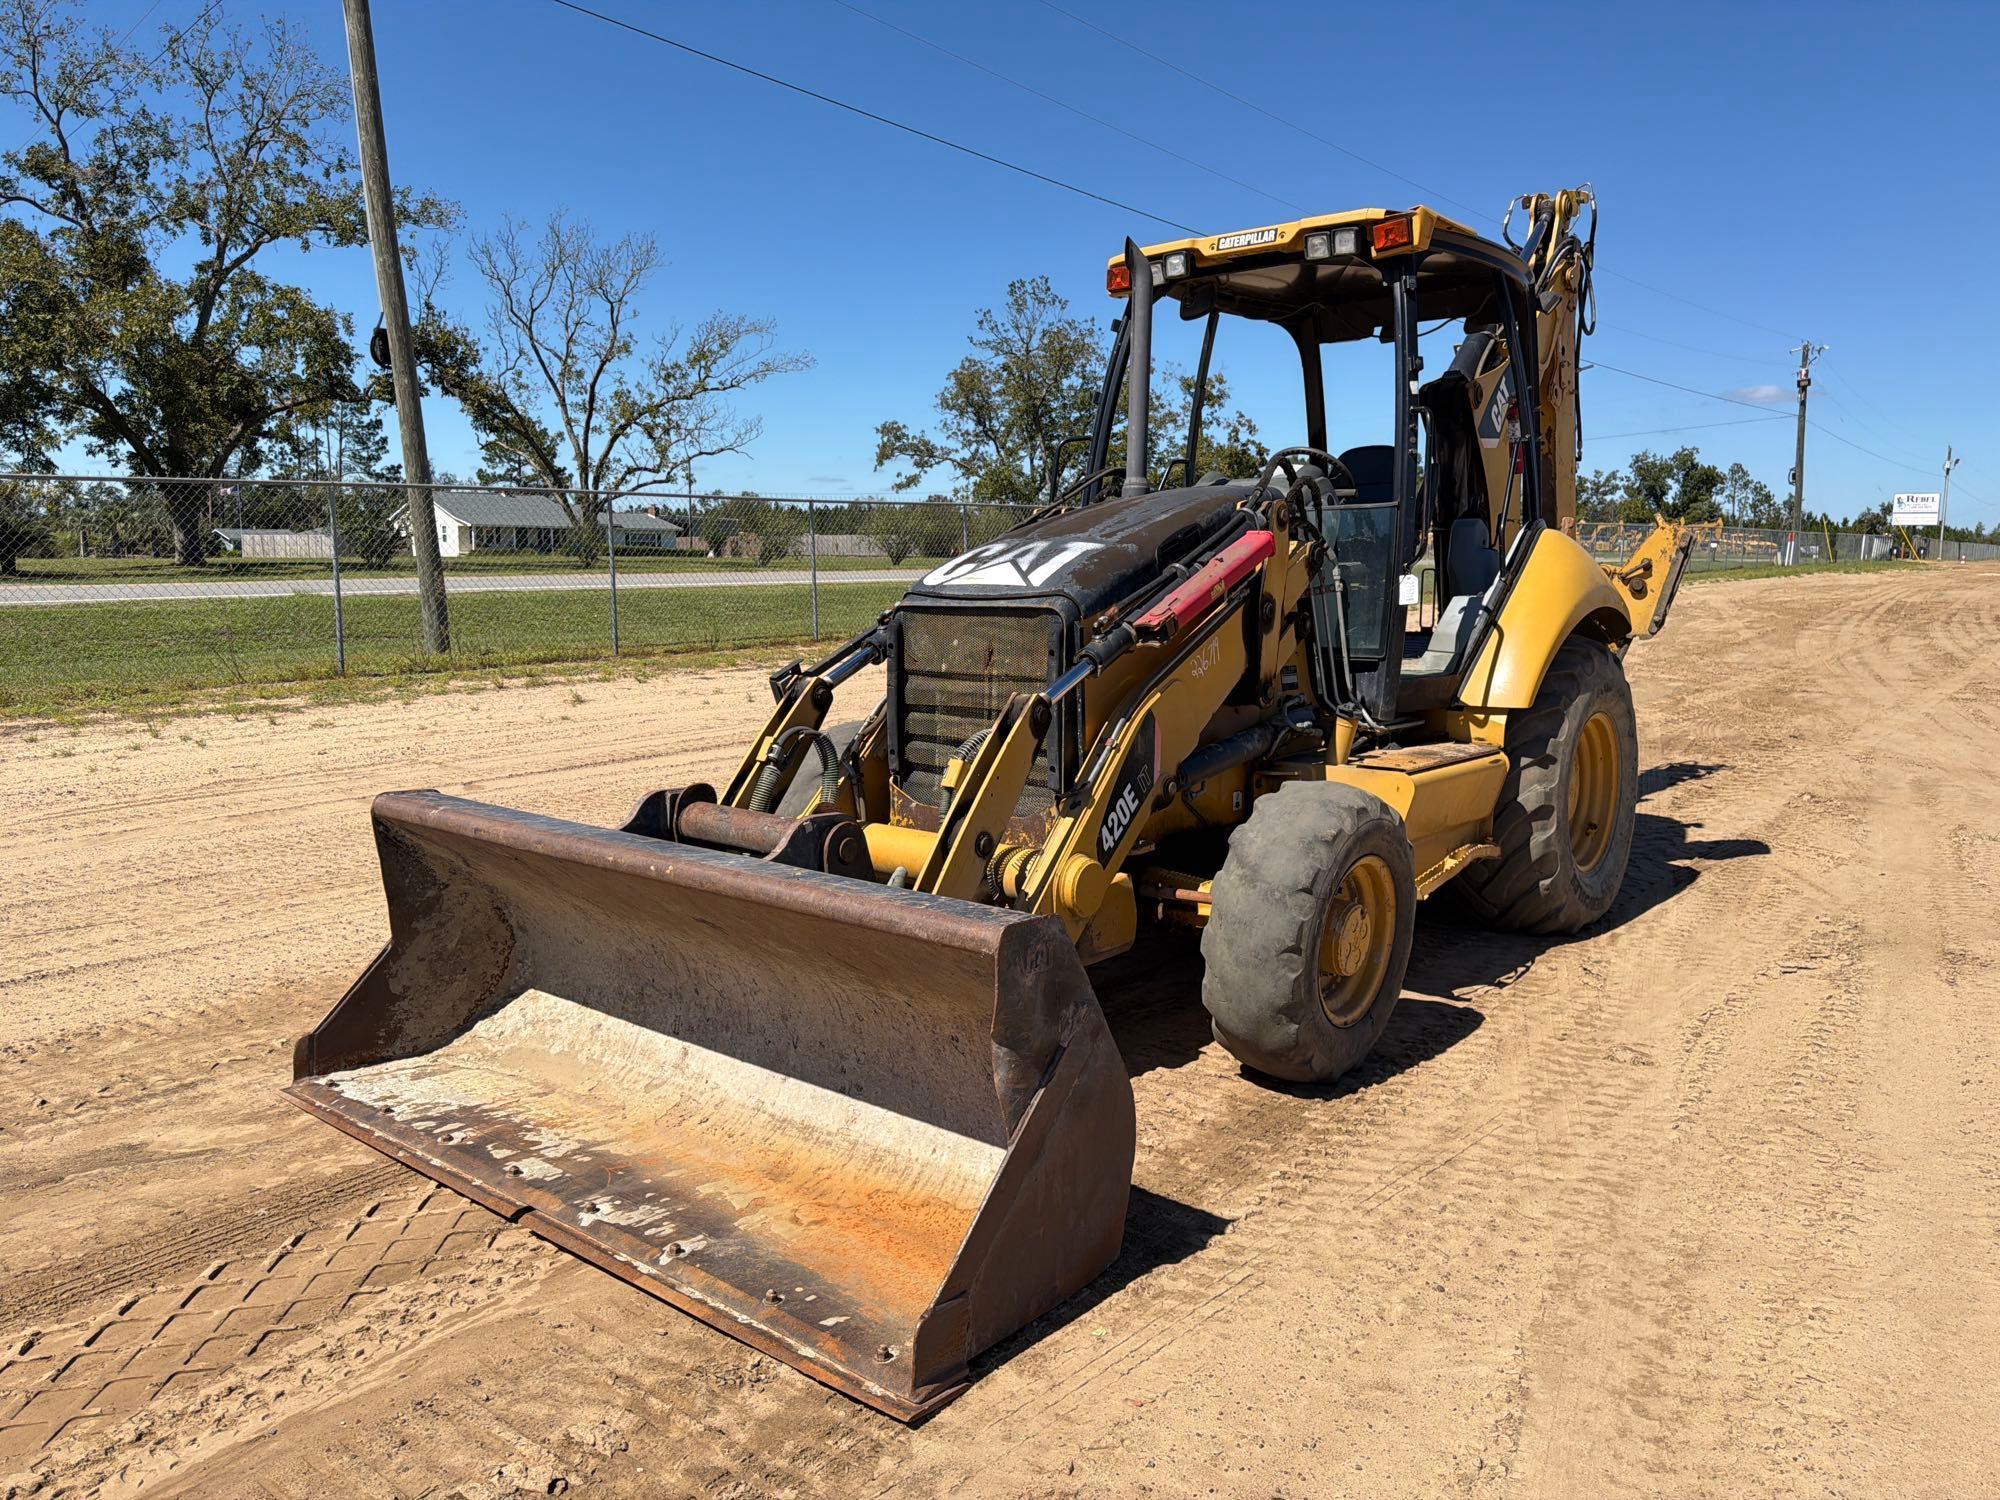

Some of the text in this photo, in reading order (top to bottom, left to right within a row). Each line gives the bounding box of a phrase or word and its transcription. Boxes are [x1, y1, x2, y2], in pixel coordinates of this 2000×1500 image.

[1219, 230, 1276, 250] CATERPILLAR
[1491, 375, 1510, 433] CAT
[923, 541, 1108, 588] CAT
[1101, 782, 1140, 852] 420E
